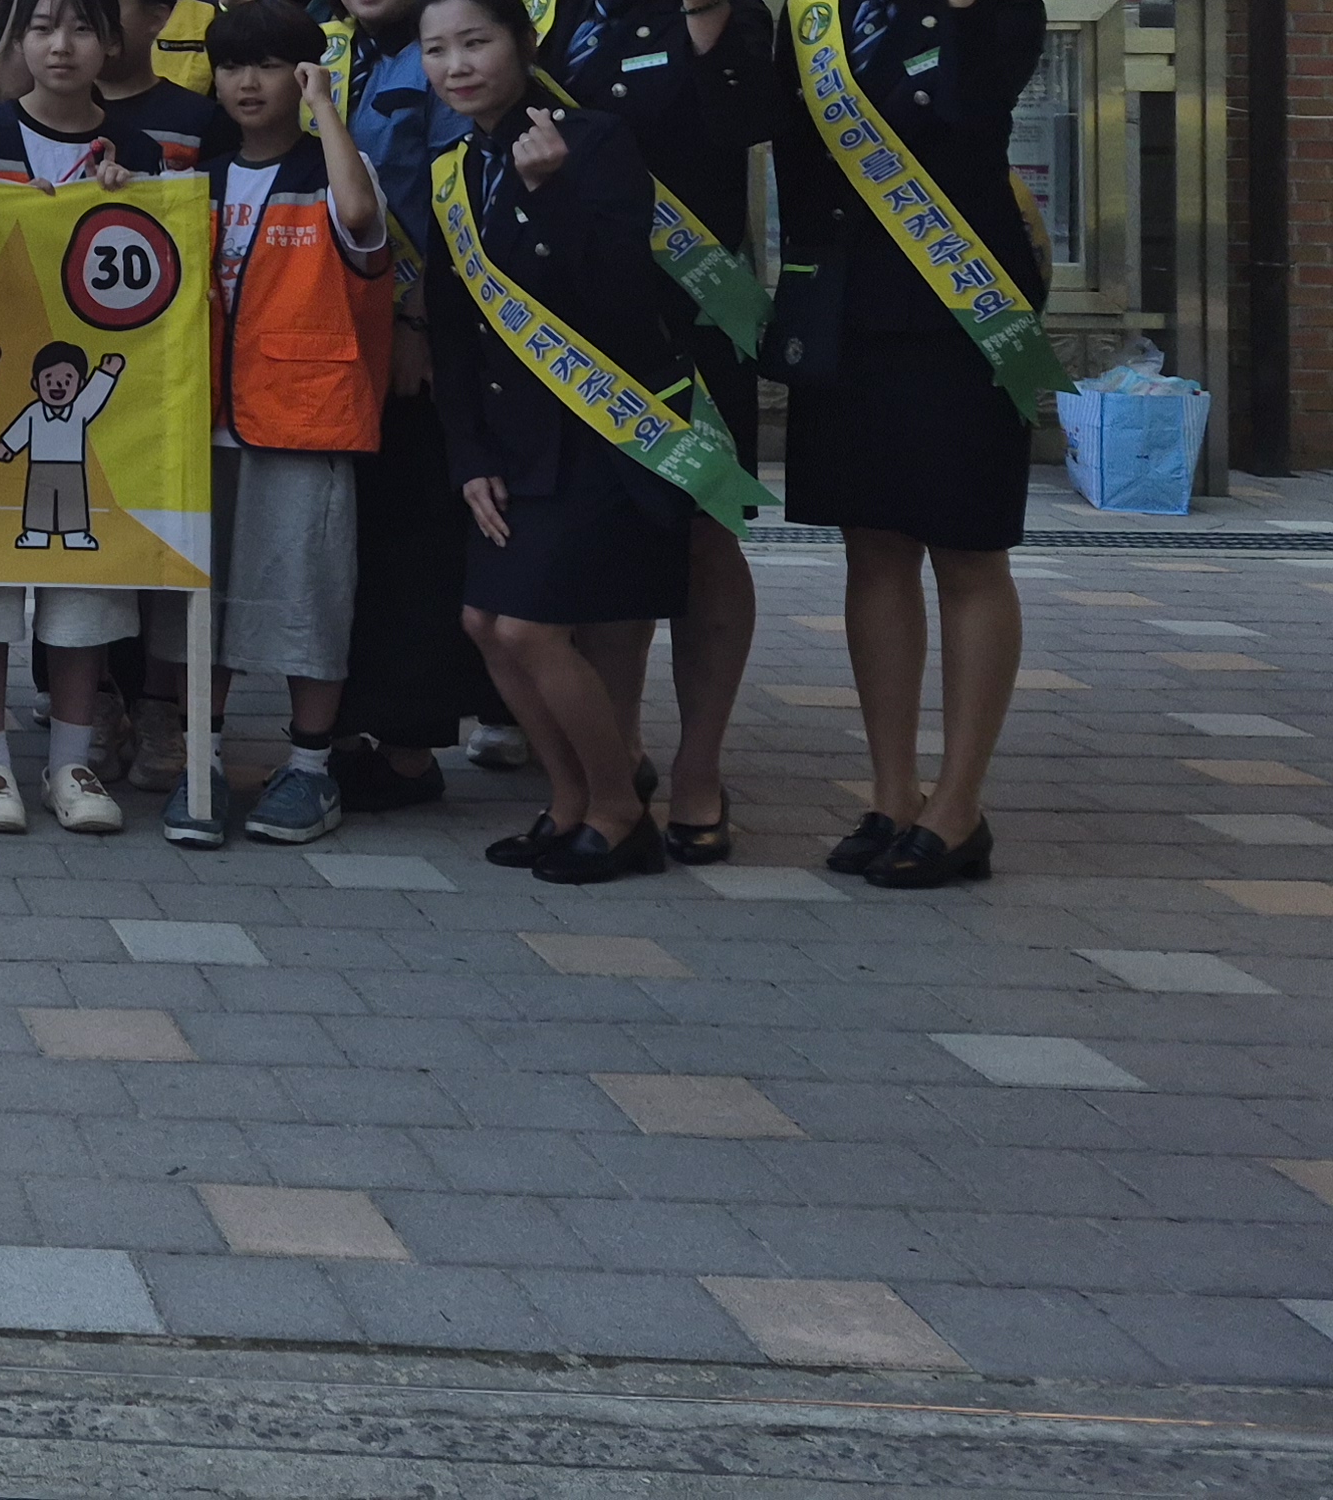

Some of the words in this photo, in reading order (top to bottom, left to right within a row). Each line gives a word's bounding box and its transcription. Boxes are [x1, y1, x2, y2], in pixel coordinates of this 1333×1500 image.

[91, 243, 152, 292] 30
[809, 46, 904, 184] 우리아이를
[883, 180, 1015, 323] 지켜주세요
[447, 203, 533, 334] 우리아이를
[525, 325, 671, 453] 지켜주세요
